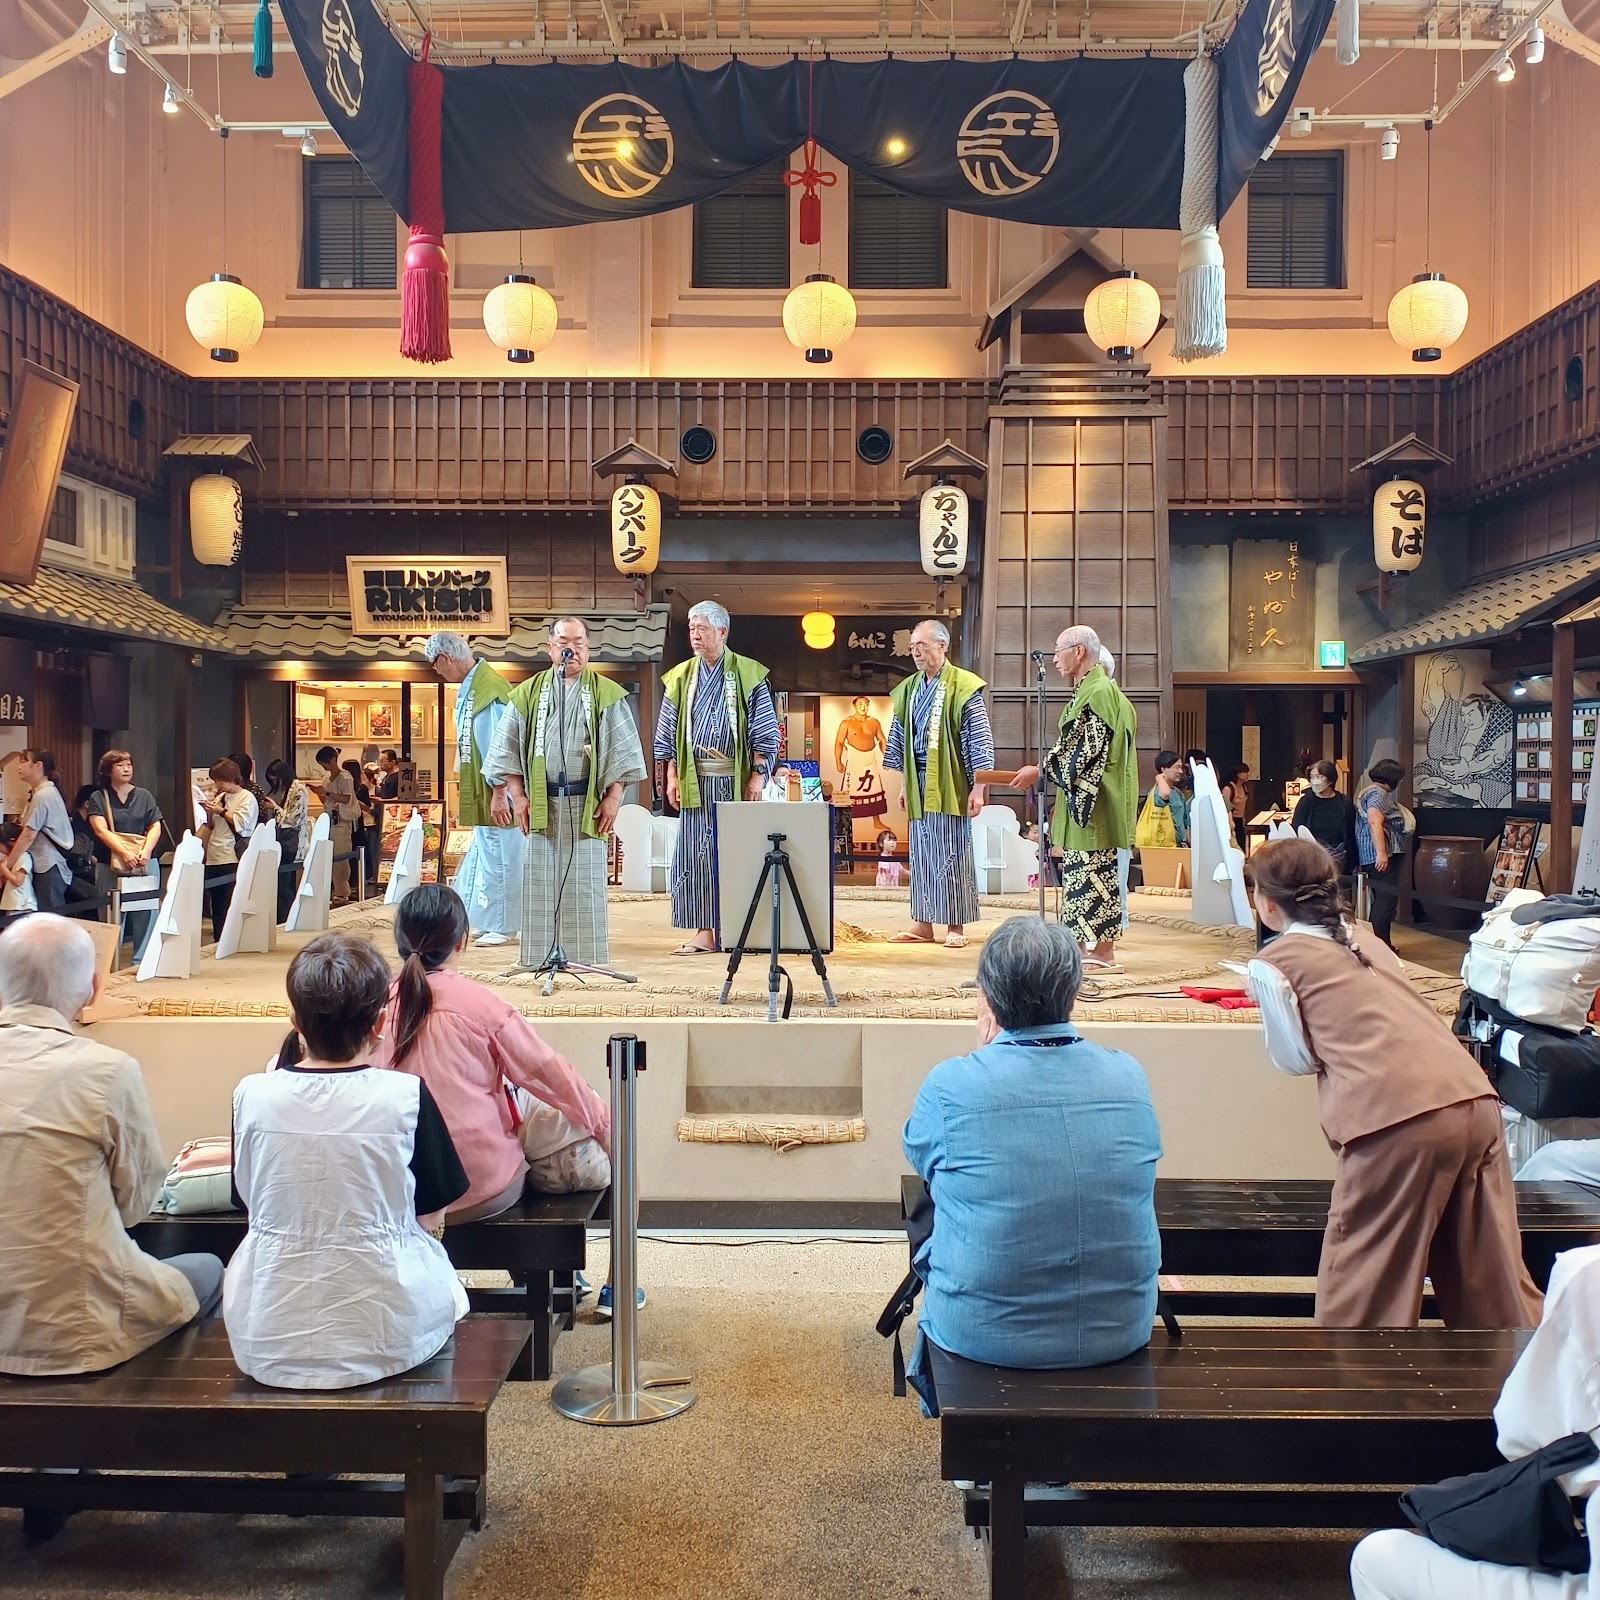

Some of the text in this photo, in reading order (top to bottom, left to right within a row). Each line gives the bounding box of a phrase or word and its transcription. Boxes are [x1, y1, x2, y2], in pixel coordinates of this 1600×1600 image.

[618, 487, 647, 563] ハンバーグ
[932, 491, 959, 568] ちゃんこ
[1390, 489, 1424, 558] そば
[363, 570, 491, 587] ハンバーグ
[365, 587, 493, 612] RIKISHI
[373, 614, 426, 622] RYOUGOKU
[430, 614, 480, 622] HAMBURG
[848, 631, 886, 649] ちゃんこ
[400, 768, 414, 800] 商い
[857, 769, 875, 793] 力
